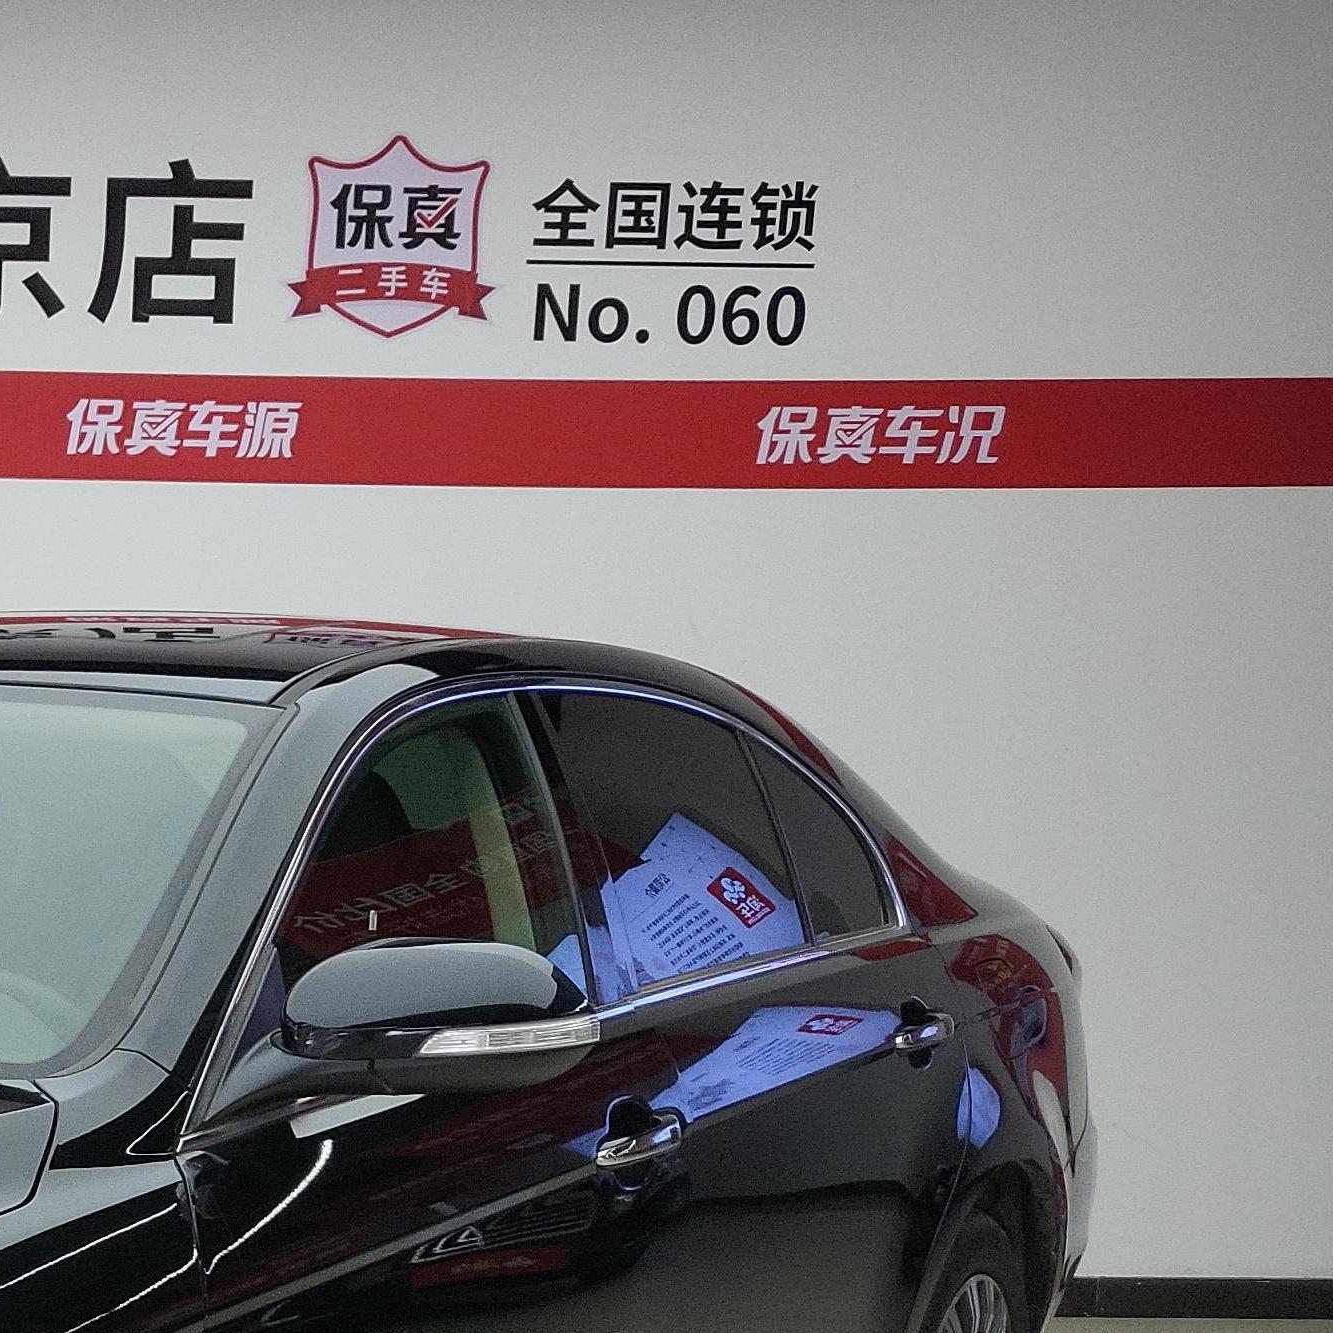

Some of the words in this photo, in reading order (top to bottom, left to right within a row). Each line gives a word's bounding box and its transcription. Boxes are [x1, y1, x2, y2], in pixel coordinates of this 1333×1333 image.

[330, 183, 464, 250] 保真
[532, 177, 819, 253] 全国连锁
[335, 265, 452, 300] 二手车
[533, 283, 650, 345] No.
[676, 284, 807, 347] 060
[66, 397, 303, 461] 保真车源
[755, 405, 1007, 465] 保真车况
